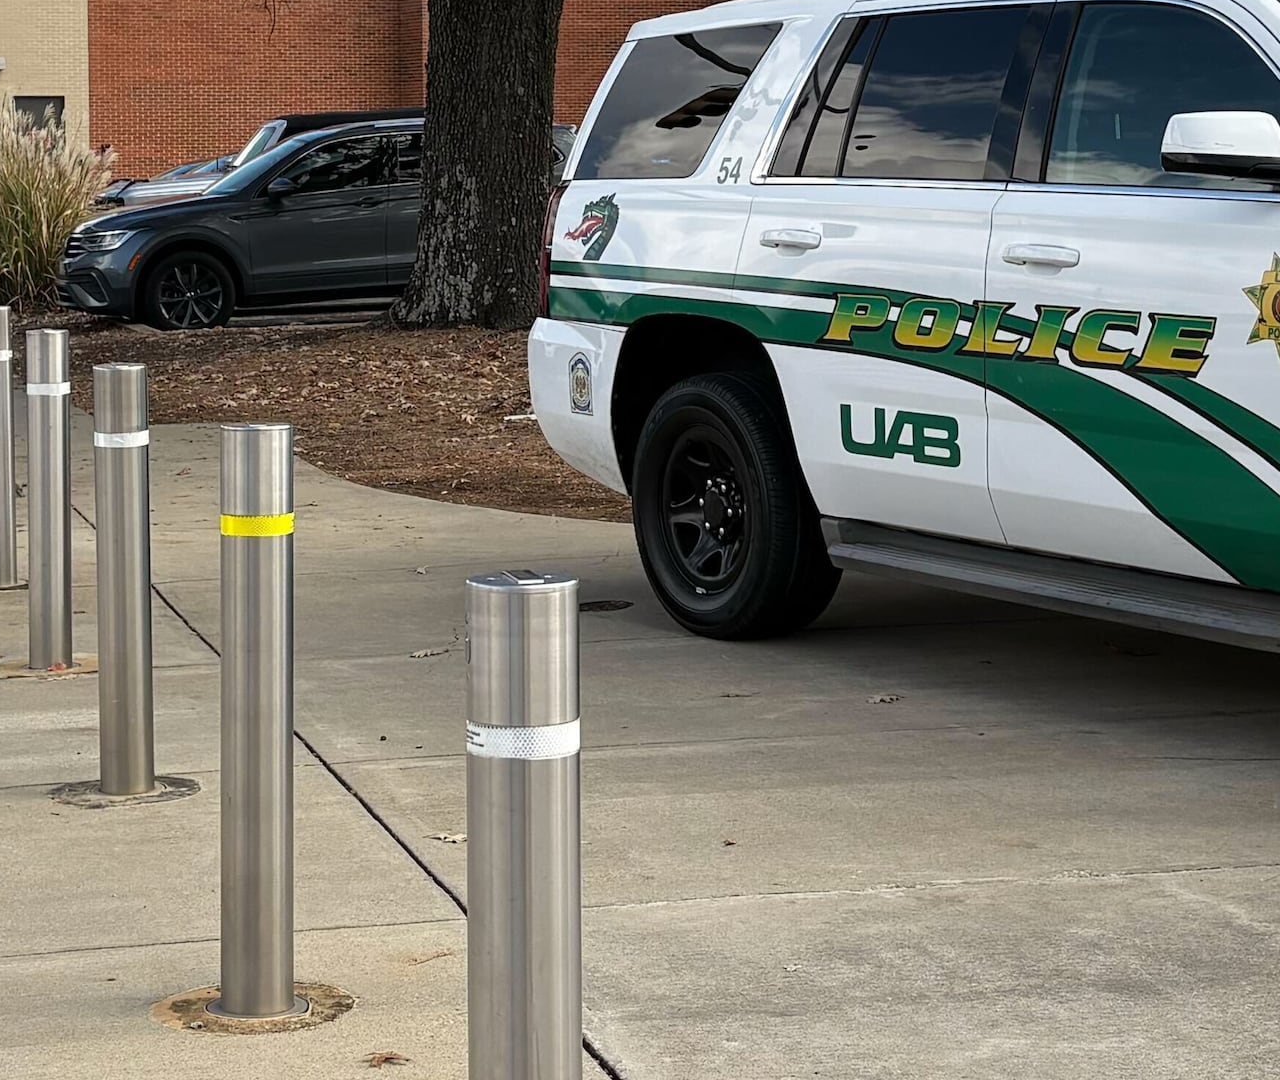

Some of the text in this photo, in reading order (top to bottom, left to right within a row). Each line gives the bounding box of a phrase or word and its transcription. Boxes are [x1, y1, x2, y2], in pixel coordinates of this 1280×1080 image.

[717, 156, 743, 184] 54
[816, 293, 1219, 379] POLICE
[840, 404, 961, 468] UAB
